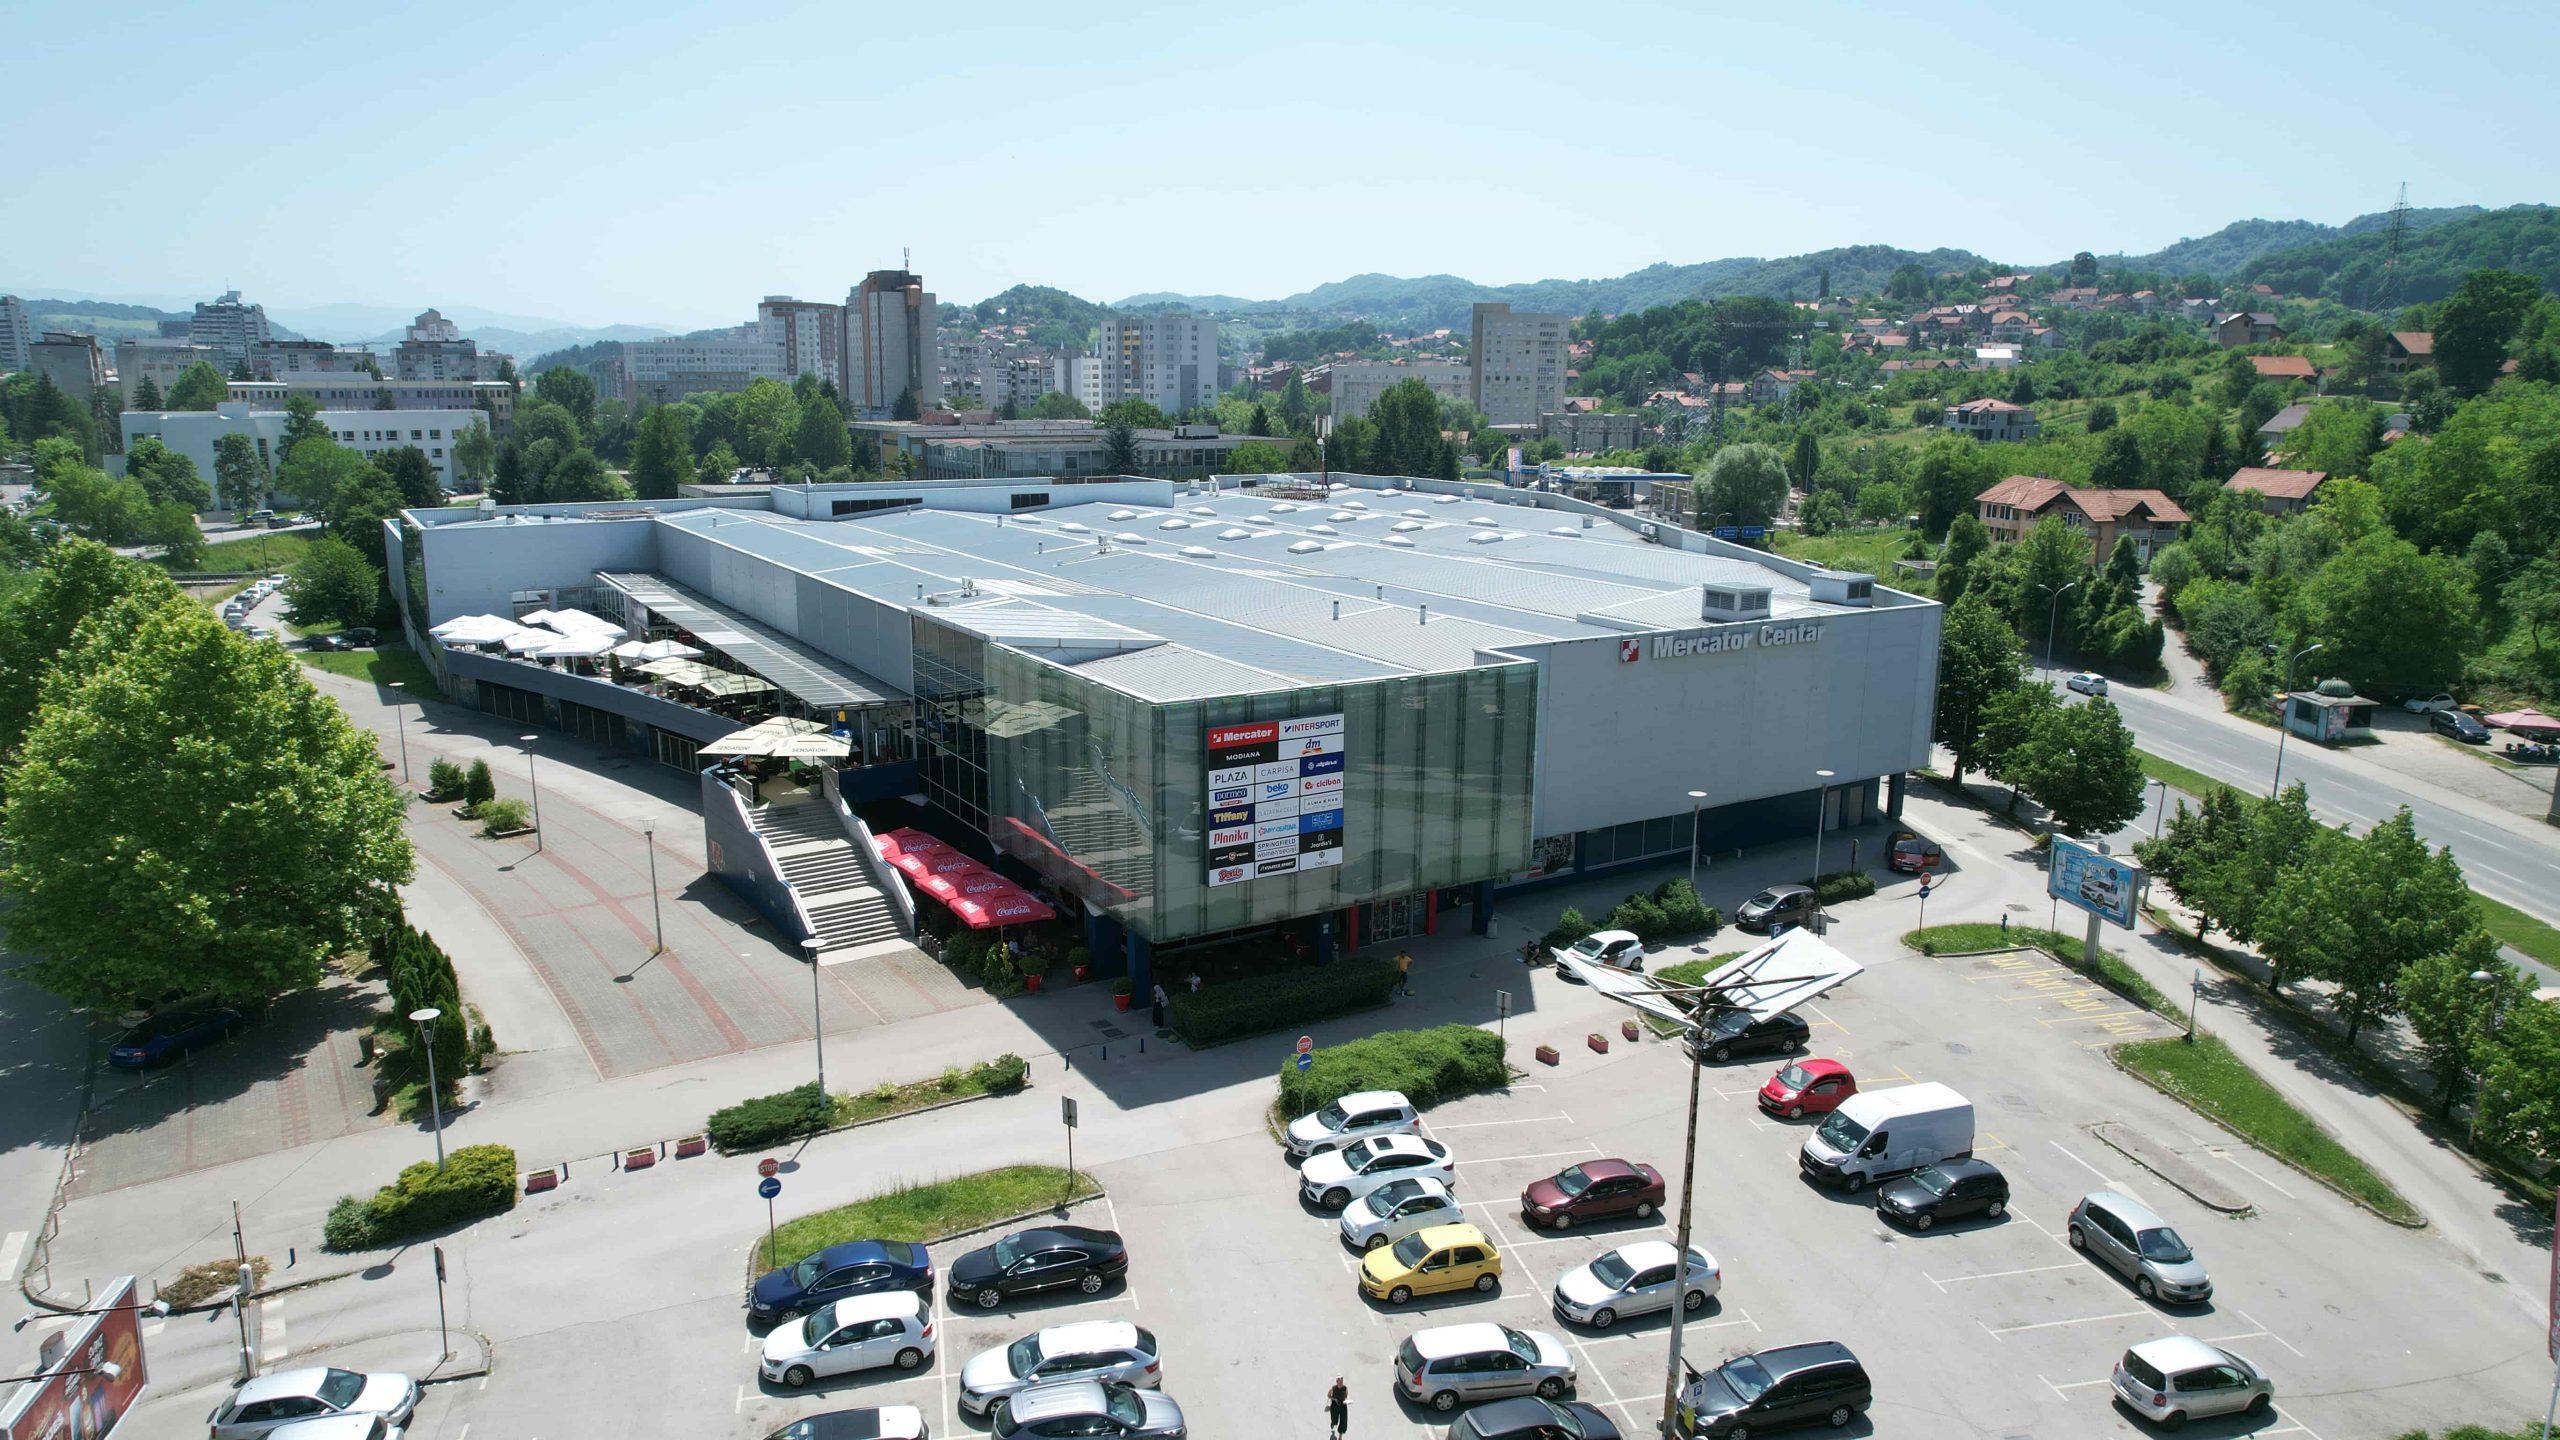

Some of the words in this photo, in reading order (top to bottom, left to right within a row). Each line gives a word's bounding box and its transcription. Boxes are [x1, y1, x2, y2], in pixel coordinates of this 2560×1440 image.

[1653, 631, 1752, 660] Mercator
[1758, 623, 1826, 647] Centar
[1291, 719, 1340, 733] INTERSPORT
[1223, 728, 1273, 742] Mercator
[1305, 738, 1321, 749] dm
[1225, 751, 1261, 761] MODIANA
[1215, 771, 1248, 784] PLAZA
[1260, 766, 1294, 777] CARPISA
[1266, 783, 1289, 793] beko
[1213, 810, 1249, 824] Tiffany
[1213, 829, 1249, 845] Planika
[1257, 838, 1296, 850] SPRINGFIELD
[996, 905, 1031, 917] Coca-Cola
[760, 1163, 778, 1173] STOP
